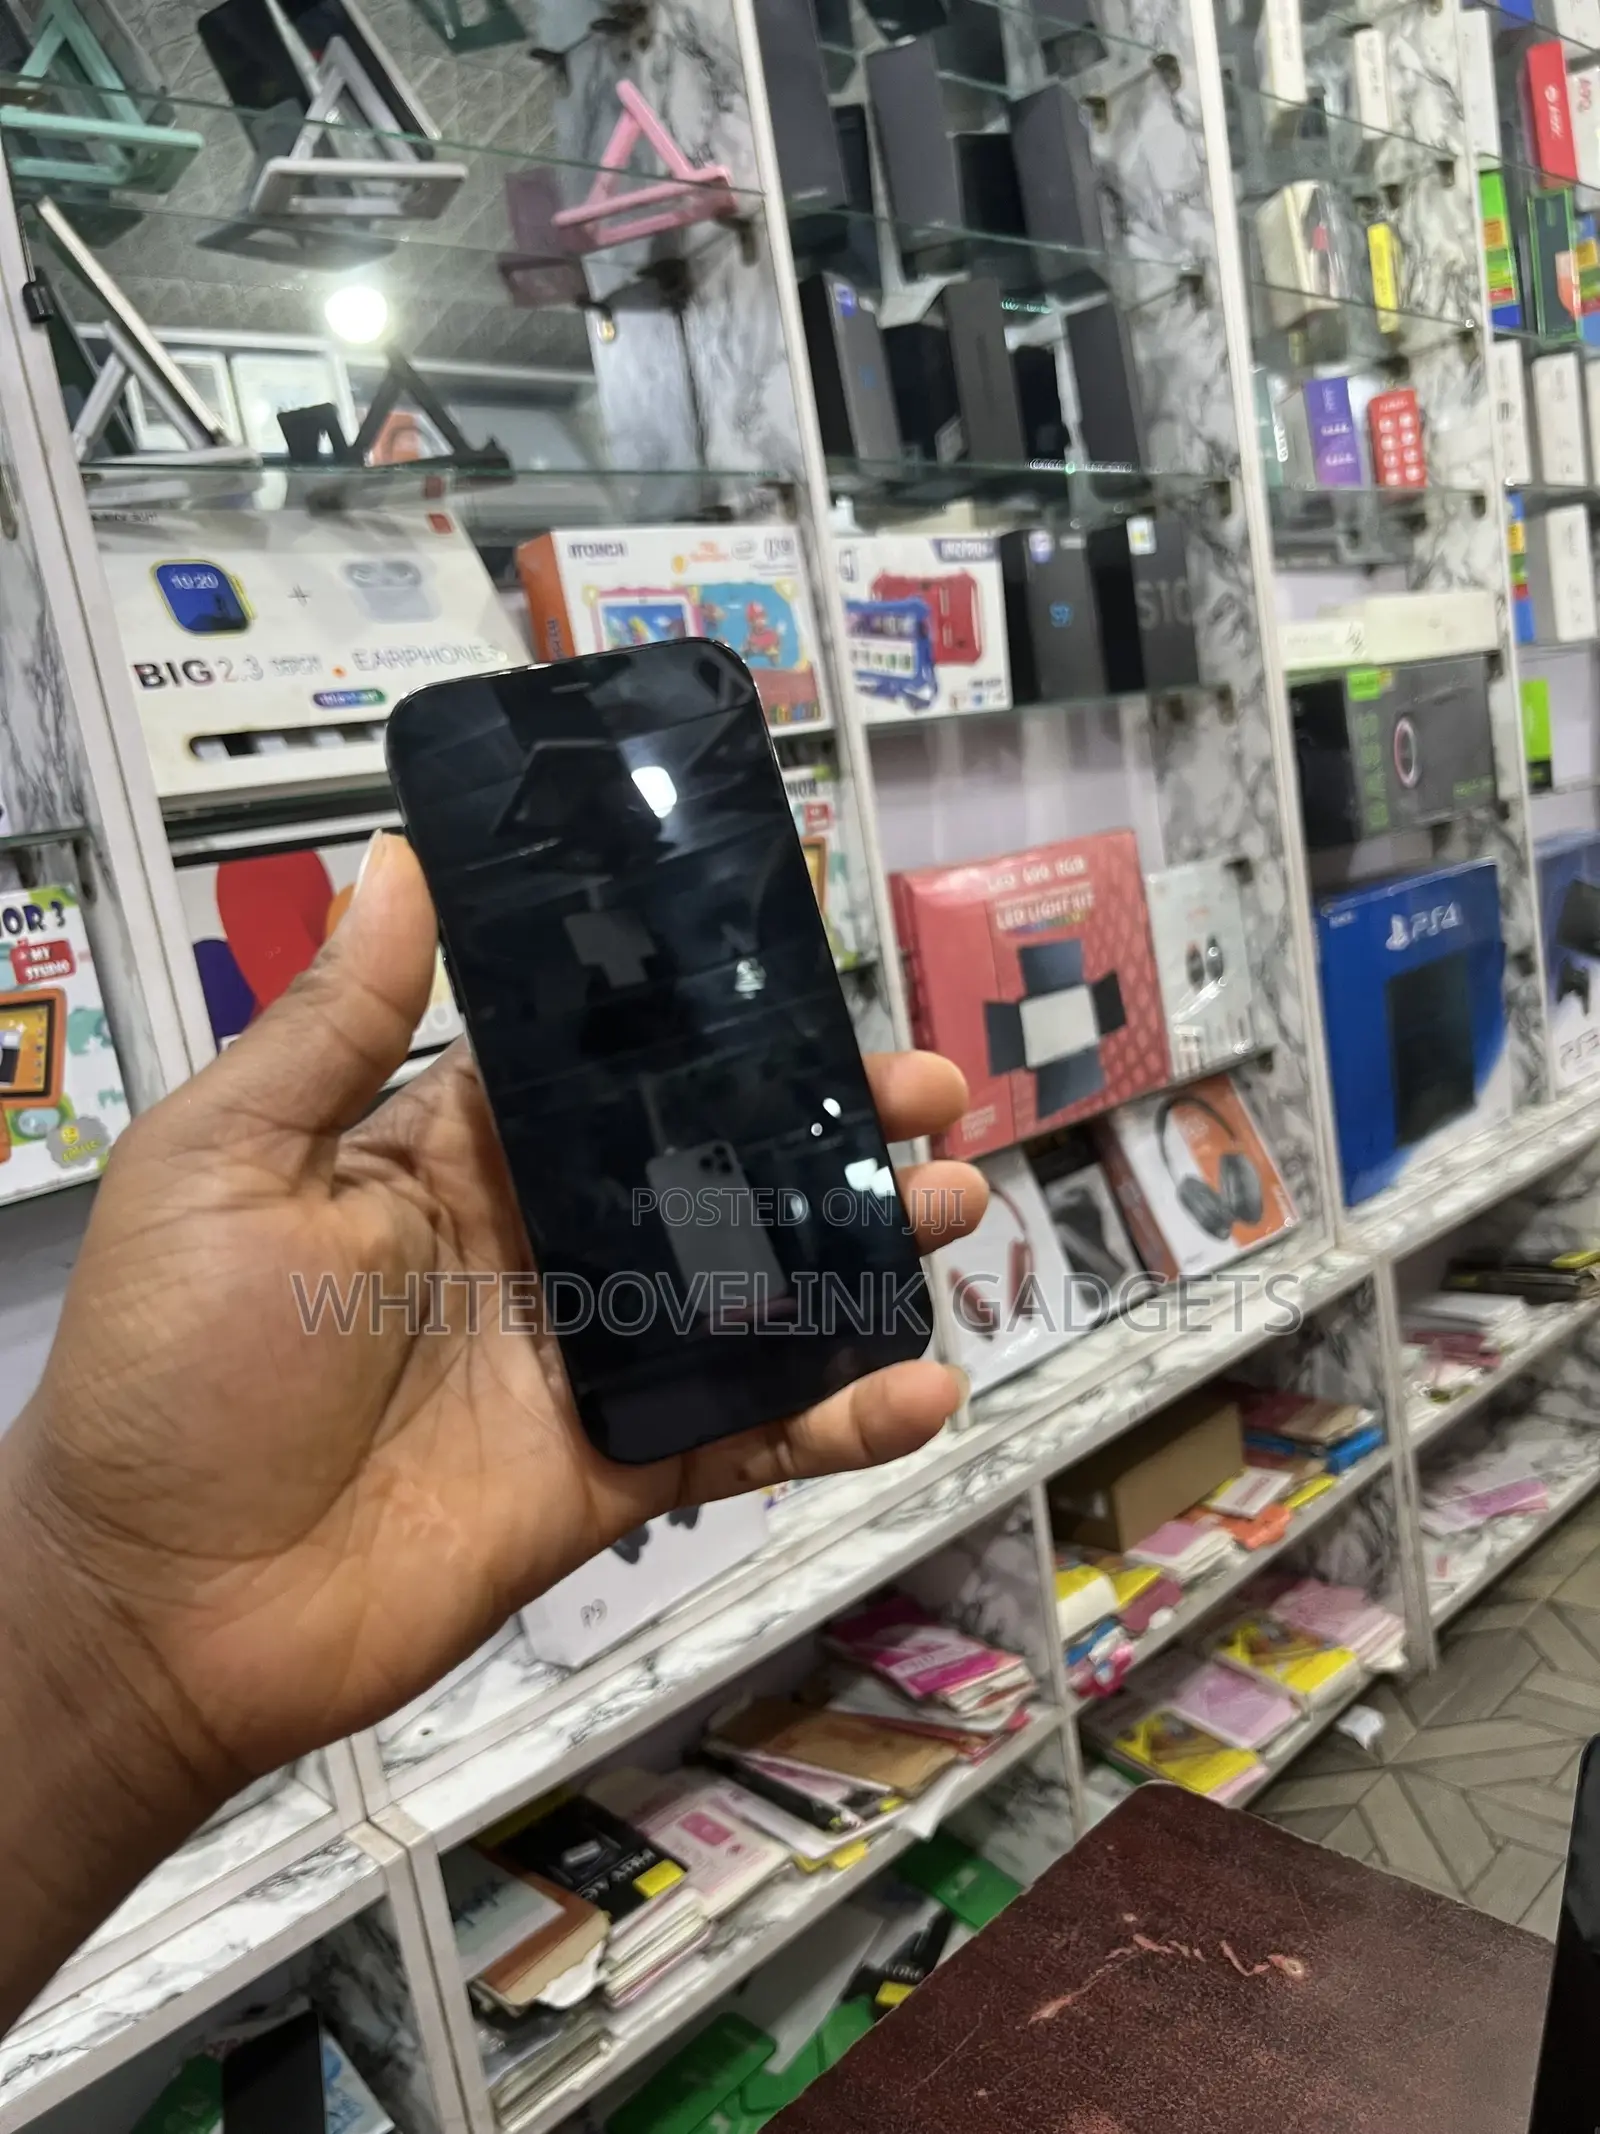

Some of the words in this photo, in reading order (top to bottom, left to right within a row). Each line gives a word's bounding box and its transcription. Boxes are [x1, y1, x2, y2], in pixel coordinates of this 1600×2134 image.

[133, 659, 214, 689] BIG
[995, 905, 1026, 931] LED
[1028, 896, 1070, 923] LIGHT
[1411, 901, 1464, 943] PS4
[30, 945, 51, 961] MY
[24, 958, 71, 981] STUDIO
